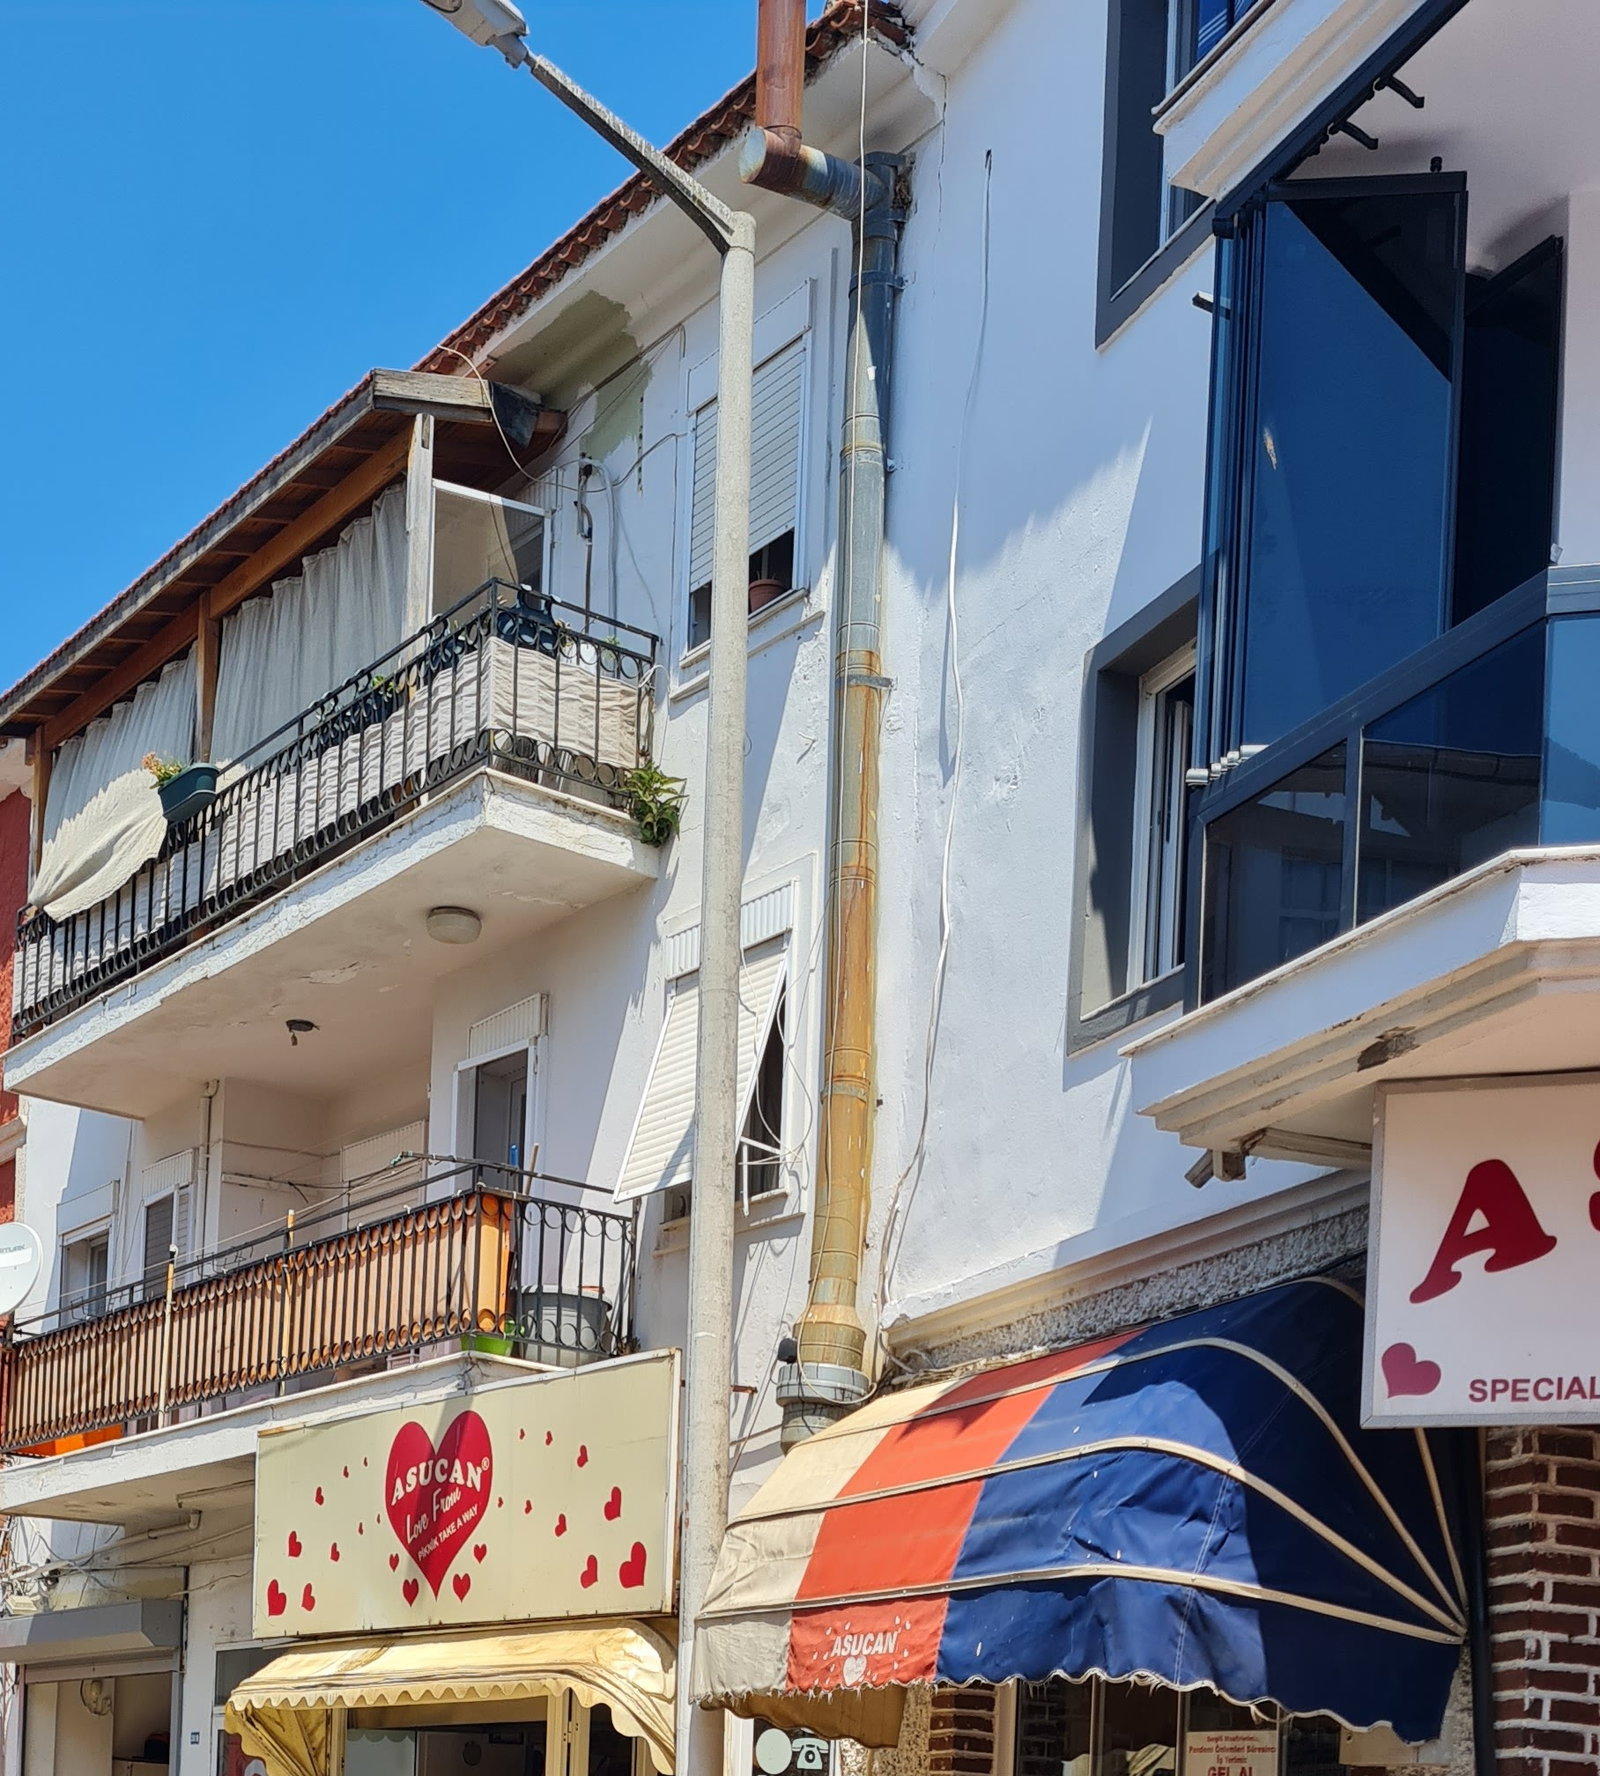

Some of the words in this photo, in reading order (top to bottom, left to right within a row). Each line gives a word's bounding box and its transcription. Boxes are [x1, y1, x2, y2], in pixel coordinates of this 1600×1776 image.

[406, 1514, 429, 1545] Love
[433, 1488, 462, 1522] From
[438, 1521, 457, 1542] TAKE
[456, 1517, 464, 1529] A
[461, 1503, 478, 1524] WAY
[830, 1630, 898, 1657] ASUCAN
